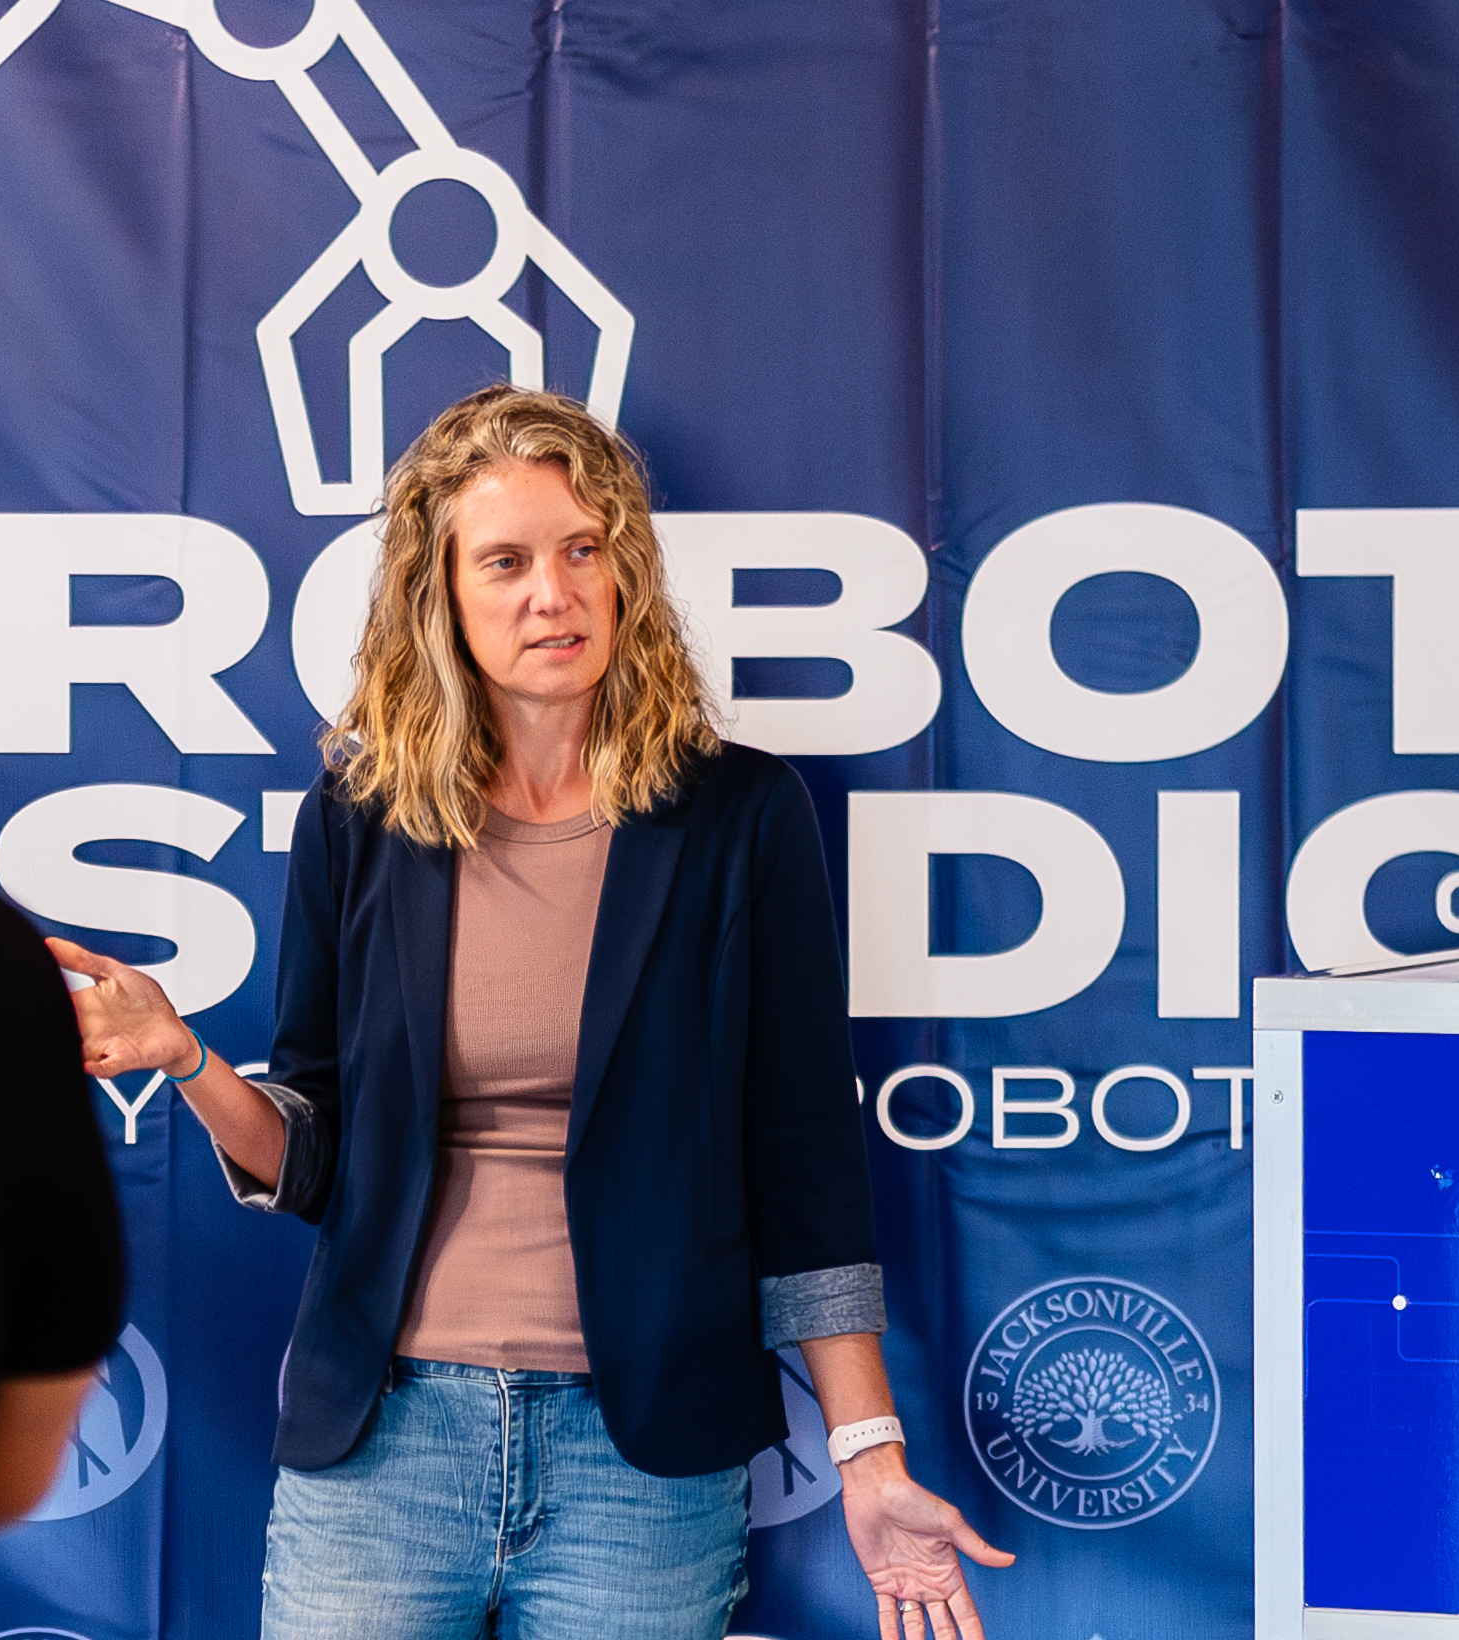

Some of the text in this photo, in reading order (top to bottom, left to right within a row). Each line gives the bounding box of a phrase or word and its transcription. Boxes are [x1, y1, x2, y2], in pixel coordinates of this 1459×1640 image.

[855, 1064, 1254, 1152] OBOT
[981, 1288, 1203, 1387] JACKSONVILLE
[975, 1391, 1210, 1413] 19 34
[986, 1431, 1197, 1517] UNIVERSITY
